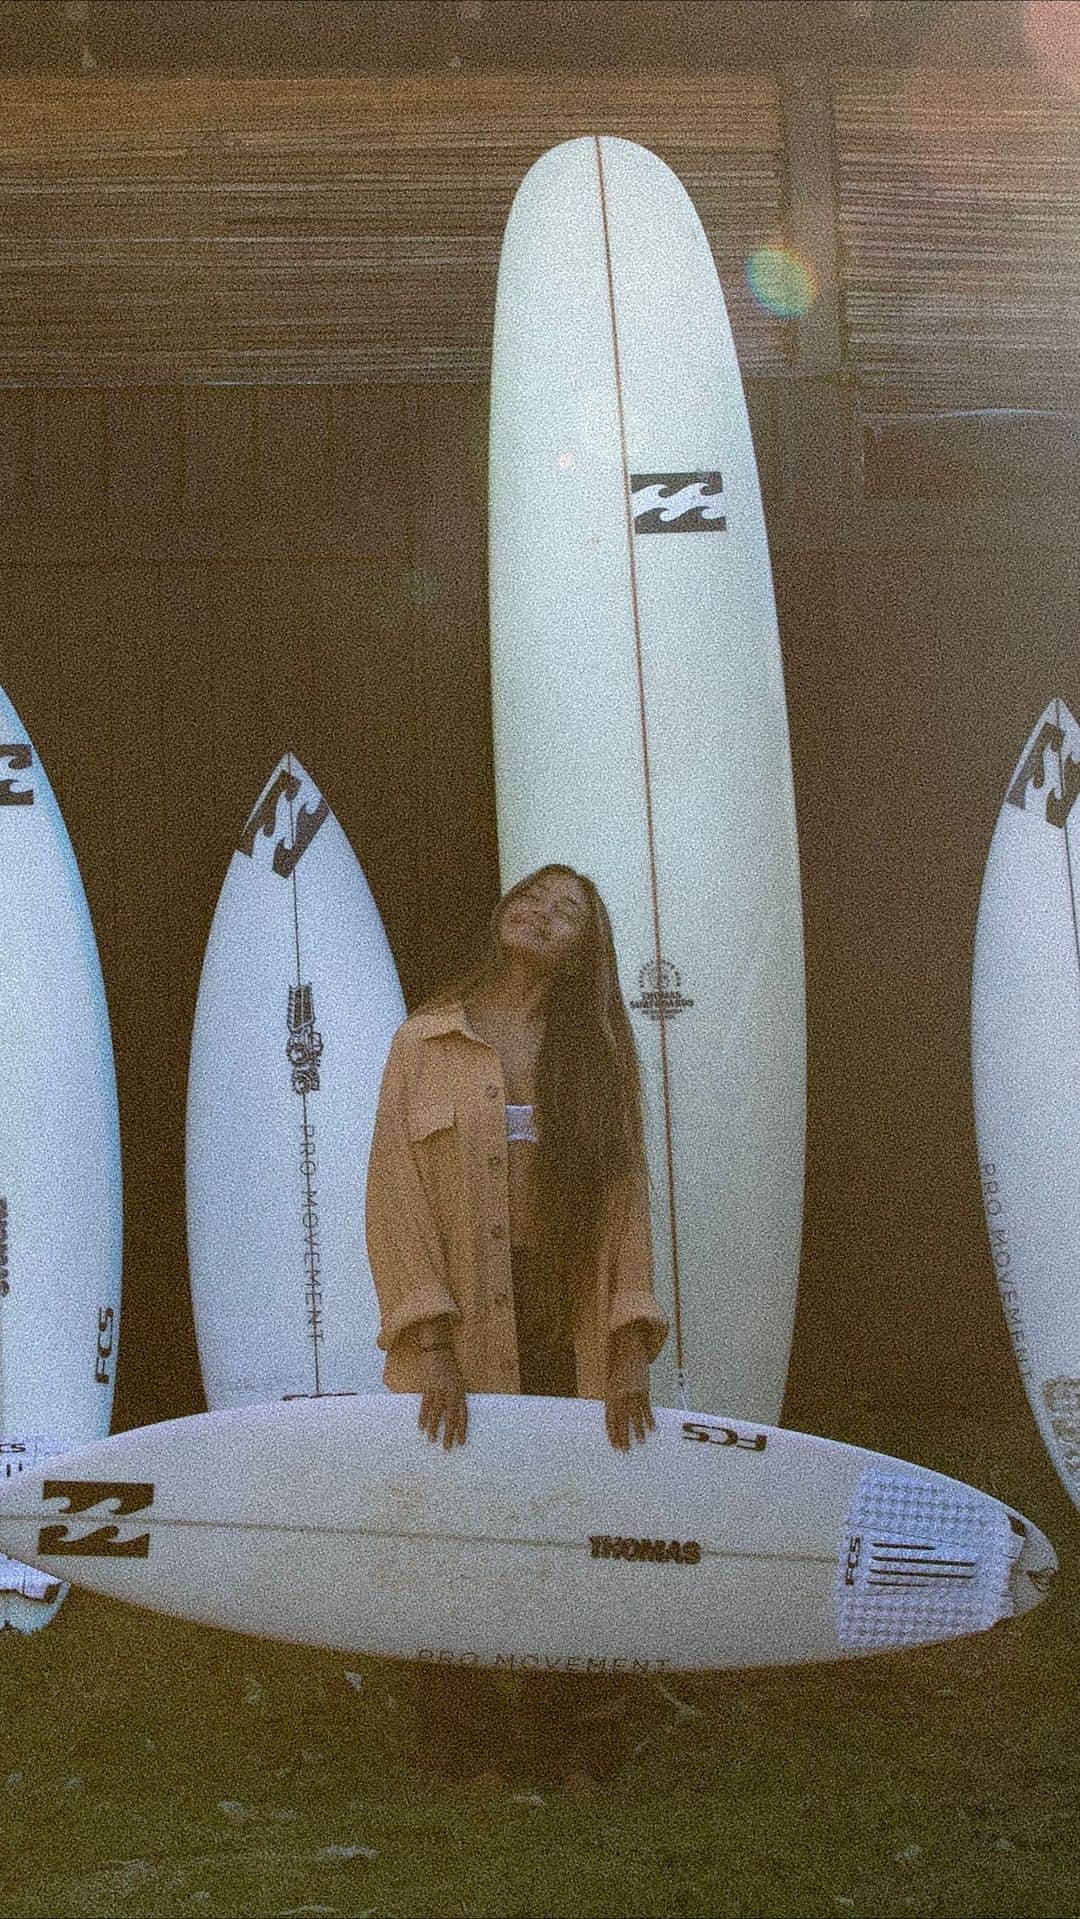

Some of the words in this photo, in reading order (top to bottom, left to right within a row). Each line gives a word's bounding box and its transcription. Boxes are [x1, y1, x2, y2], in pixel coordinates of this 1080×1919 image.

[300, 1124, 317, 1176] PRO
[982, 1162, 1002, 1217] PRO
[302, 1190, 324, 1342] MOVEMENT
[94, 1306, 115, 1385] FCS
[0, 1442, 26, 1453] CS
[682, 1422, 768, 1451] FCS
[589, 1534, 701, 1565] THOMAS
[845, 1536, 861, 1586] FCS
[417, 1649, 479, 1665] PRO
[495, 1653, 672, 1673] MOVEMENT
